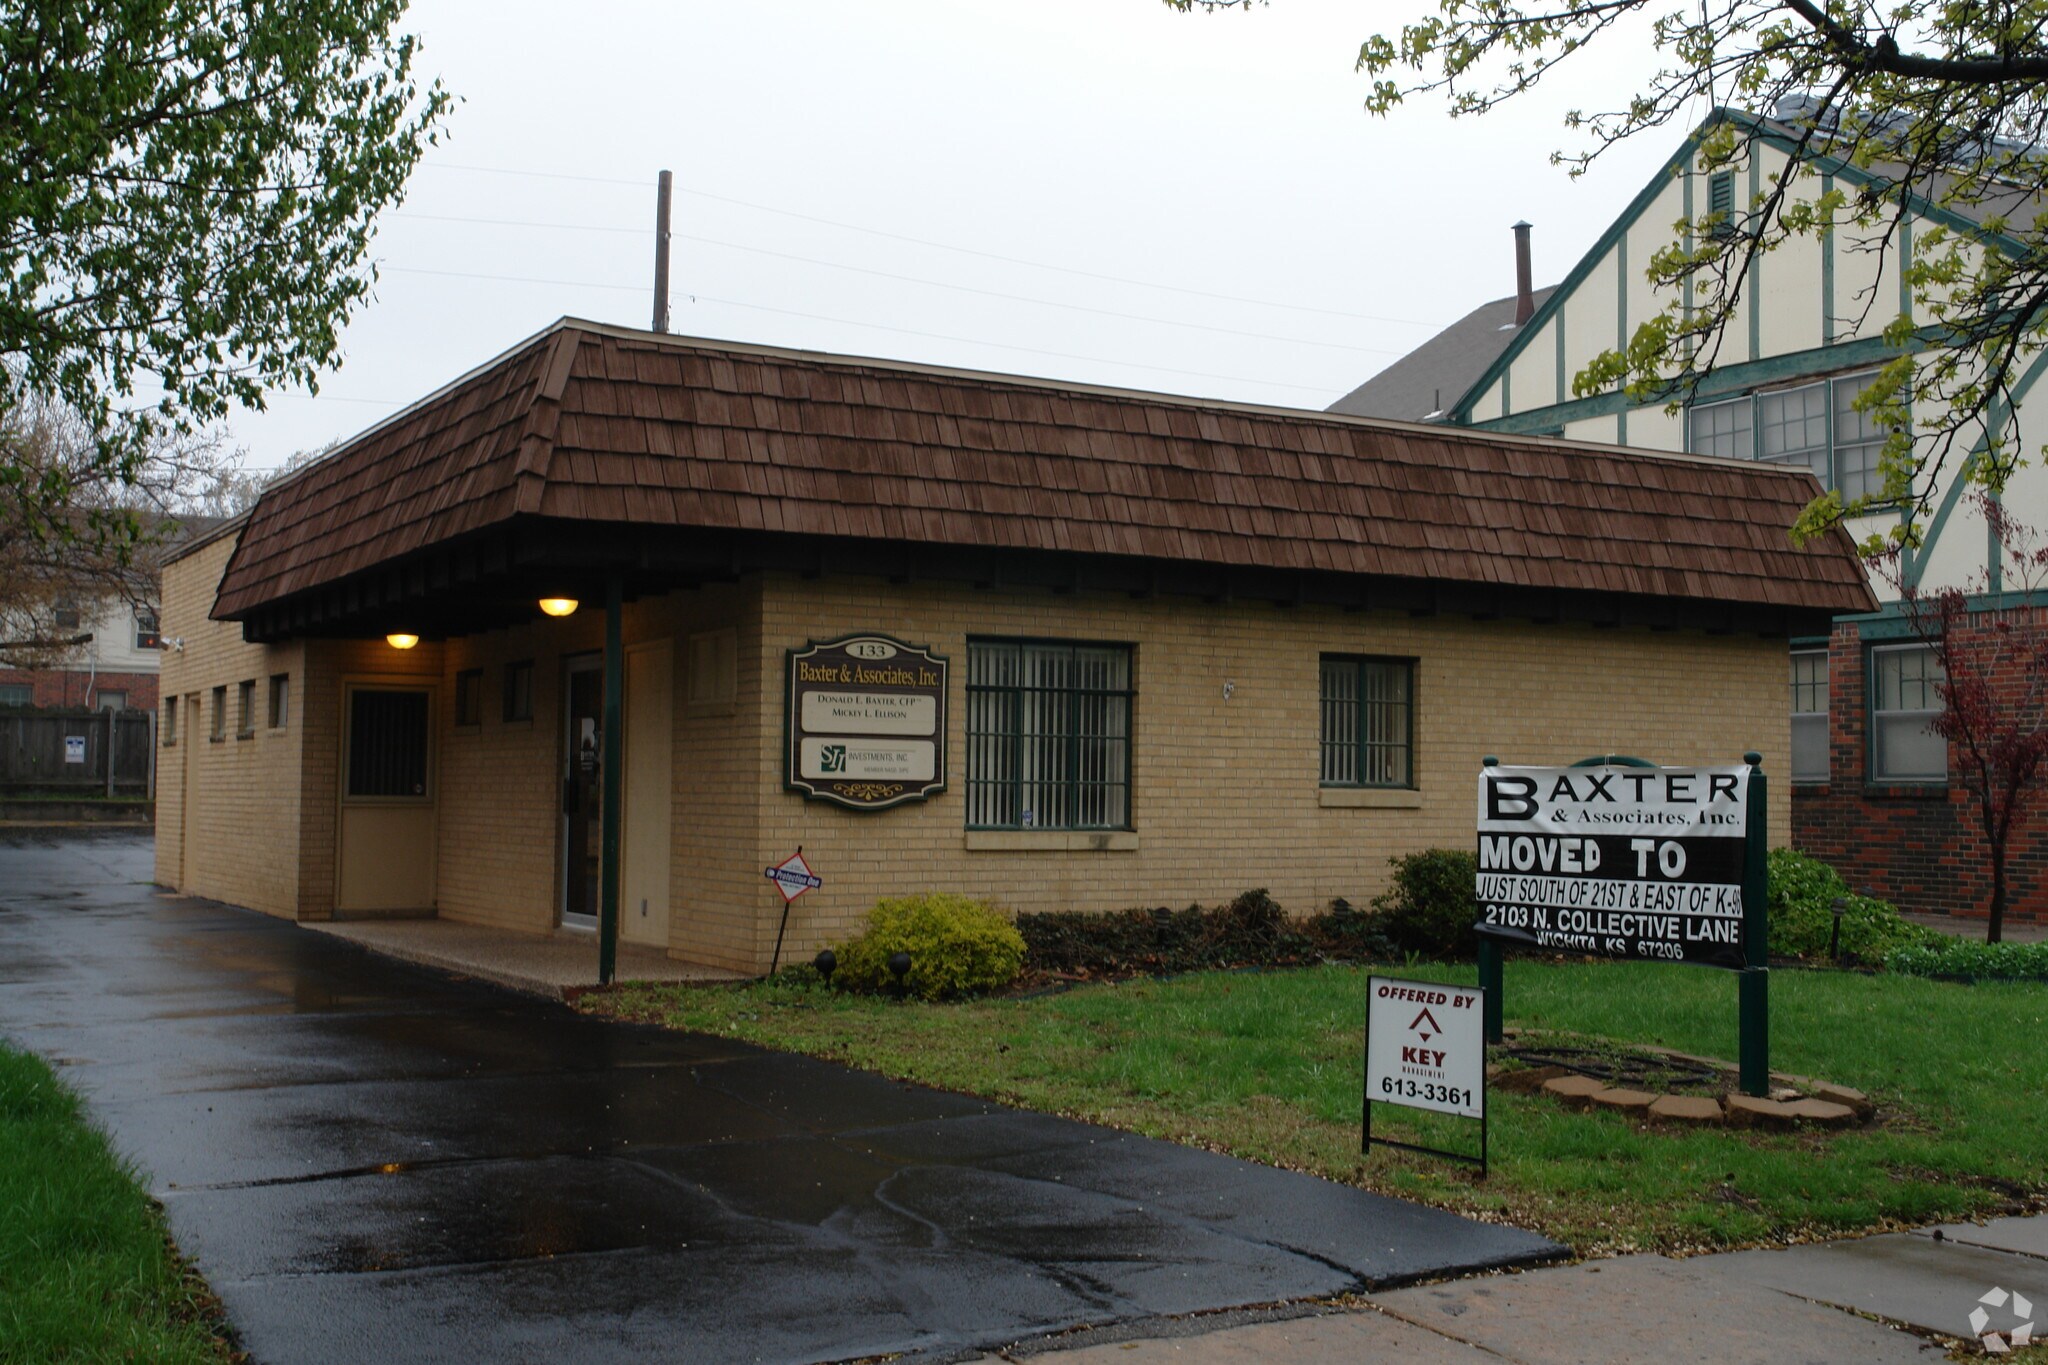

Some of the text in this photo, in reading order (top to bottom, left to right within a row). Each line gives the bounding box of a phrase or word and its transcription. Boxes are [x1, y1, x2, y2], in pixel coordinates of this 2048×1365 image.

[857, 644, 886, 657] 133
[800, 662, 939, 688] Baxter & Associates, Inc.
[817, 694, 853, 704] DONALD
[832, 708, 862, 718] MICKEY
[875, 710, 907, 719] ELLISON
[1485, 773, 1739, 821] BAXTER
[1551, 808, 1740, 826] & Associates, Inc.
[1480, 835, 1687, 878] MOVED TO
[776, 870, 807, 885] Protection
[1477, 876, 1742, 916] JUST SOUTH OF 21ST & EAST OF K-96
[1486, 904, 1739, 944] 2103 N. COLLECTIVE LANE
[1605, 938, 1626, 954] KS
[1638, 940, 1683, 960] 67206
[1378, 986, 1476, 1009] OFFERED BY
[1402, 1046, 1446, 1068] KEY
[1402, 1066, 1445, 1079] MANAGEMENT
[1382, 1076, 1471, 1107] 613-3361
